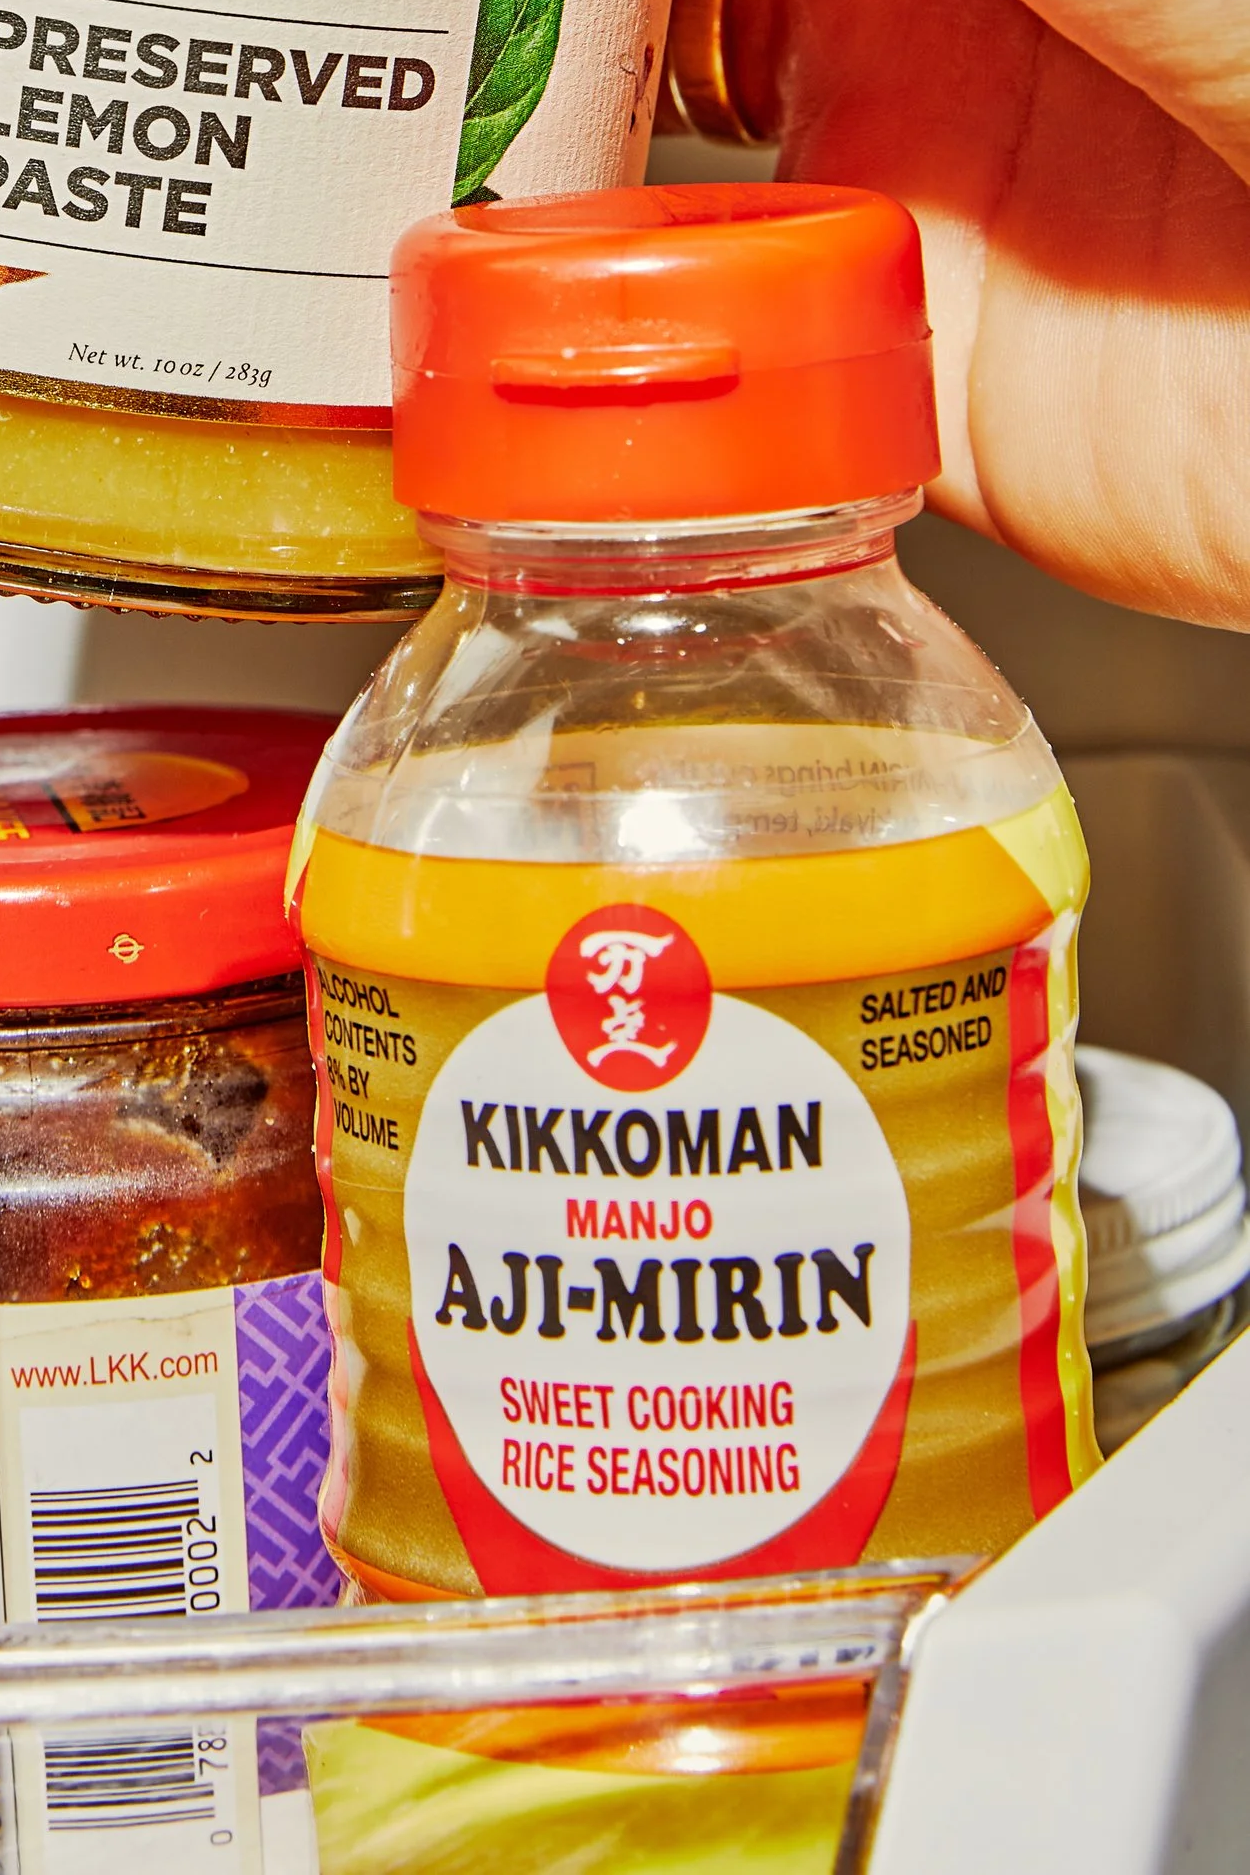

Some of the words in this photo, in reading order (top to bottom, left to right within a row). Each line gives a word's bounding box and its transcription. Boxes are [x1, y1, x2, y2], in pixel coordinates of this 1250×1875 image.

[68, 342, 107, 365] Net
[114, 354, 144, 371] wt.
[225, 362, 273, 388] 283g
[317, 967, 400, 1018] ALCOHOL
[860, 980, 957, 1024] SALTED
[960, 966, 1007, 1006] AND
[324, 1010, 417, 1066] CONTENTS
[860, 1015, 992, 1071] SEASONED
[326, 1055, 347, 1091] 8%
[347, 1065, 370, 1099] BY
[333, 1097, 399, 1151] VOLUME
[461, 1100, 823, 1177] KIKKOMAN
[566, 1200, 713, 1240] MANJO
[436, 1243, 875, 1343] AJI-MIRIN
[11, 1350, 218, 1389] www.LKK.com
[501, 1378, 613, 1431] SWEET
[628, 1380, 794, 1429] COOKING
[190, 1449, 213, 1465] 2
[501, 1439, 575, 1491] RICE
[588, 1443, 800, 1496] SEASONING
